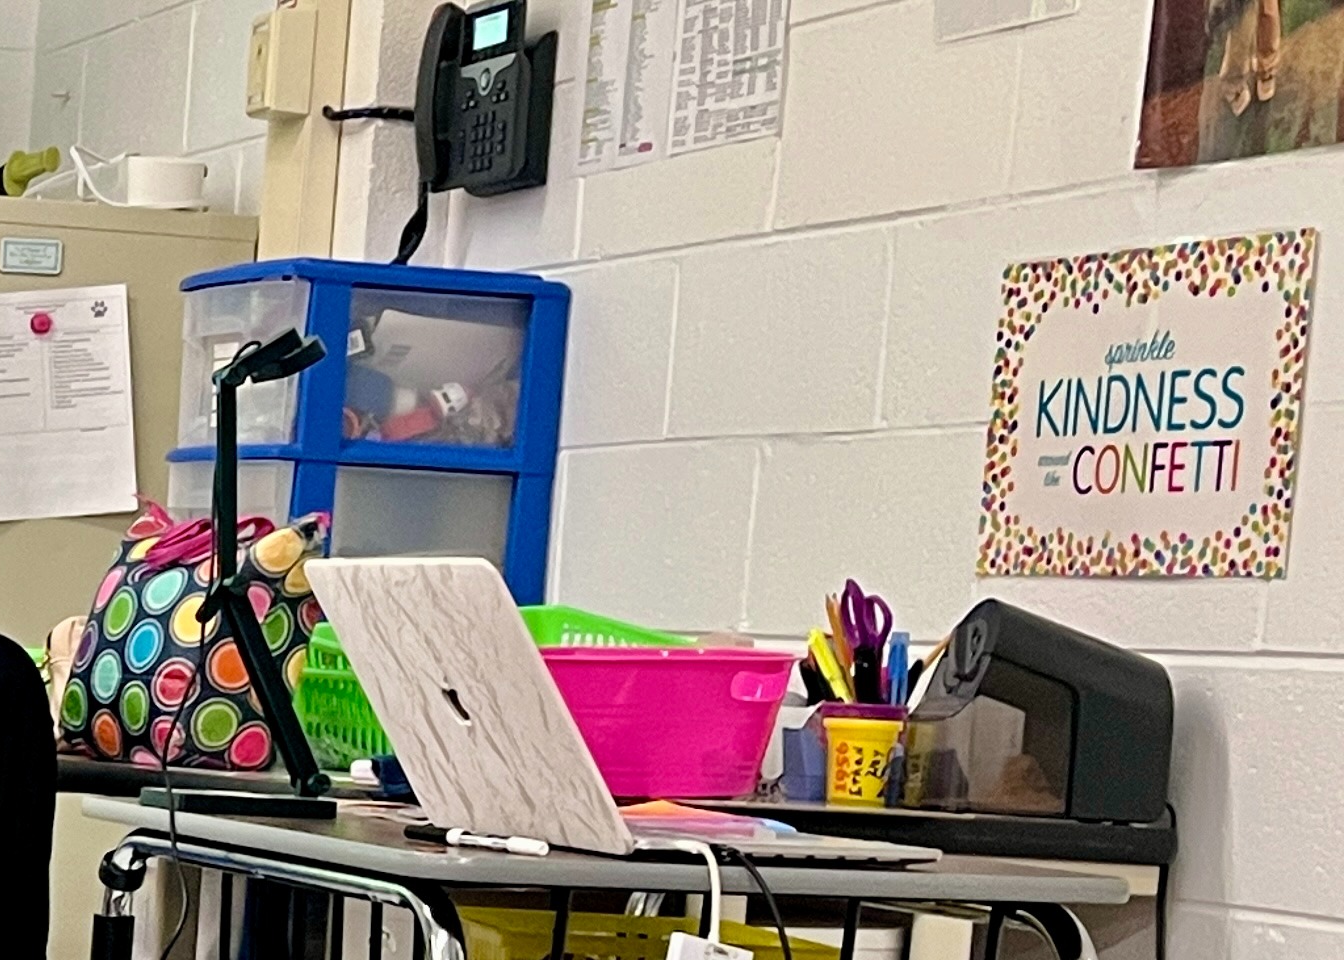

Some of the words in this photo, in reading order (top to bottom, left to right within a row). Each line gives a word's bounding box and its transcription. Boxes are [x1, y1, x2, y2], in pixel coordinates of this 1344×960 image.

[1104, 330, 1175, 370] sprinkle
[1035, 365, 1246, 438] KINDNESS
[1072, 439, 1241, 495] CONFETTI
[834, 741, 851, 792] 1956
